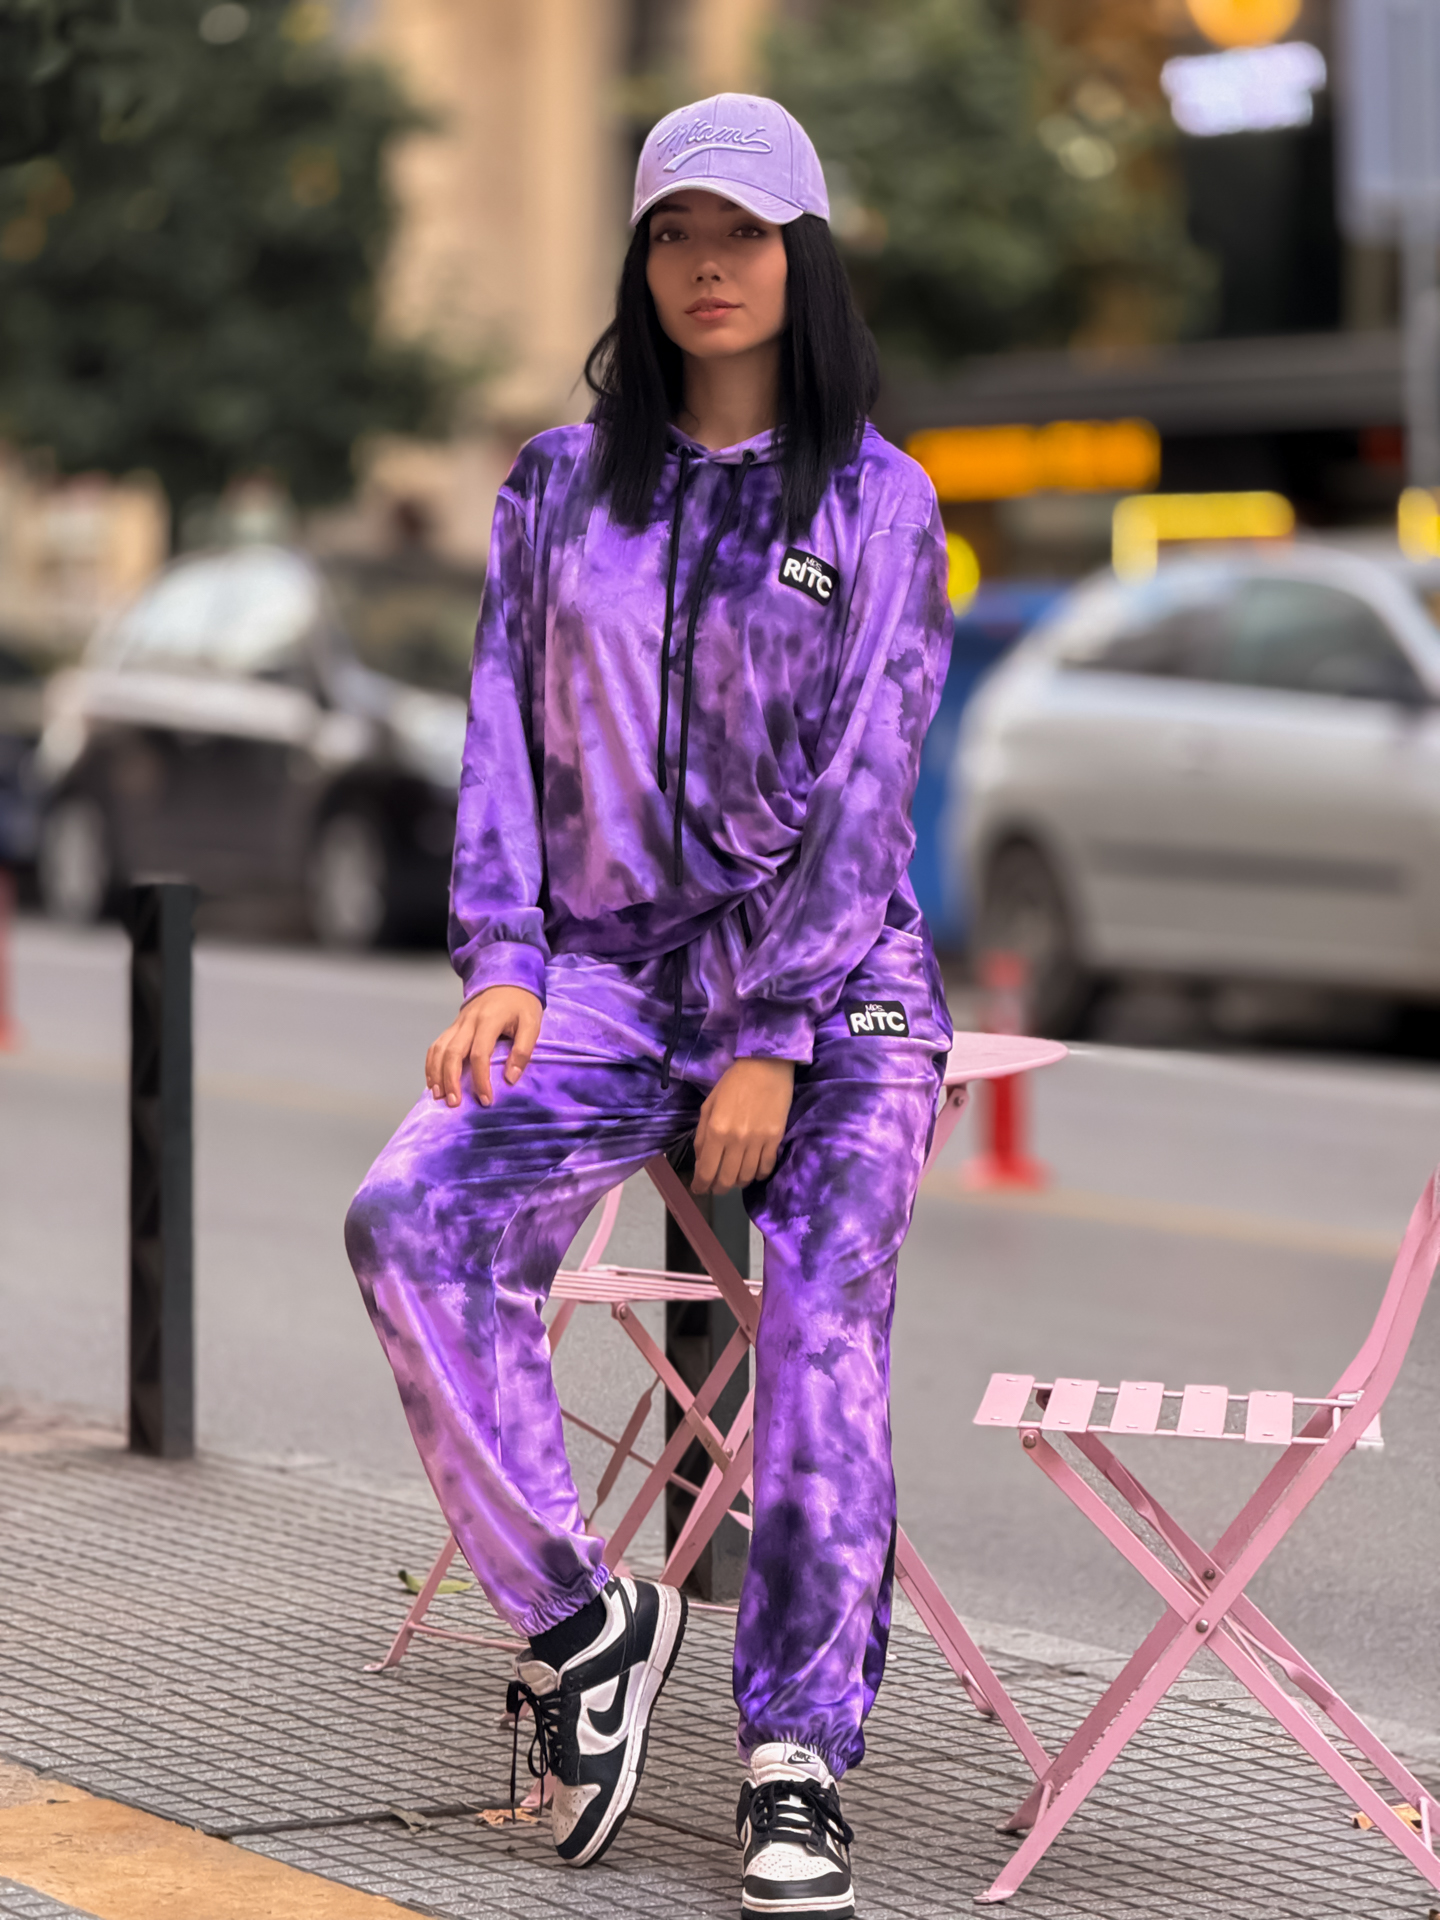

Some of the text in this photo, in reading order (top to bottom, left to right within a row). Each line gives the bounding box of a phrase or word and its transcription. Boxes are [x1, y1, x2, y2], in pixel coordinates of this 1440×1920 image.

[657, 118, 773, 171] Miami
[783, 558, 832, 598] RITC
[850, 1011, 905, 1033] RITC
